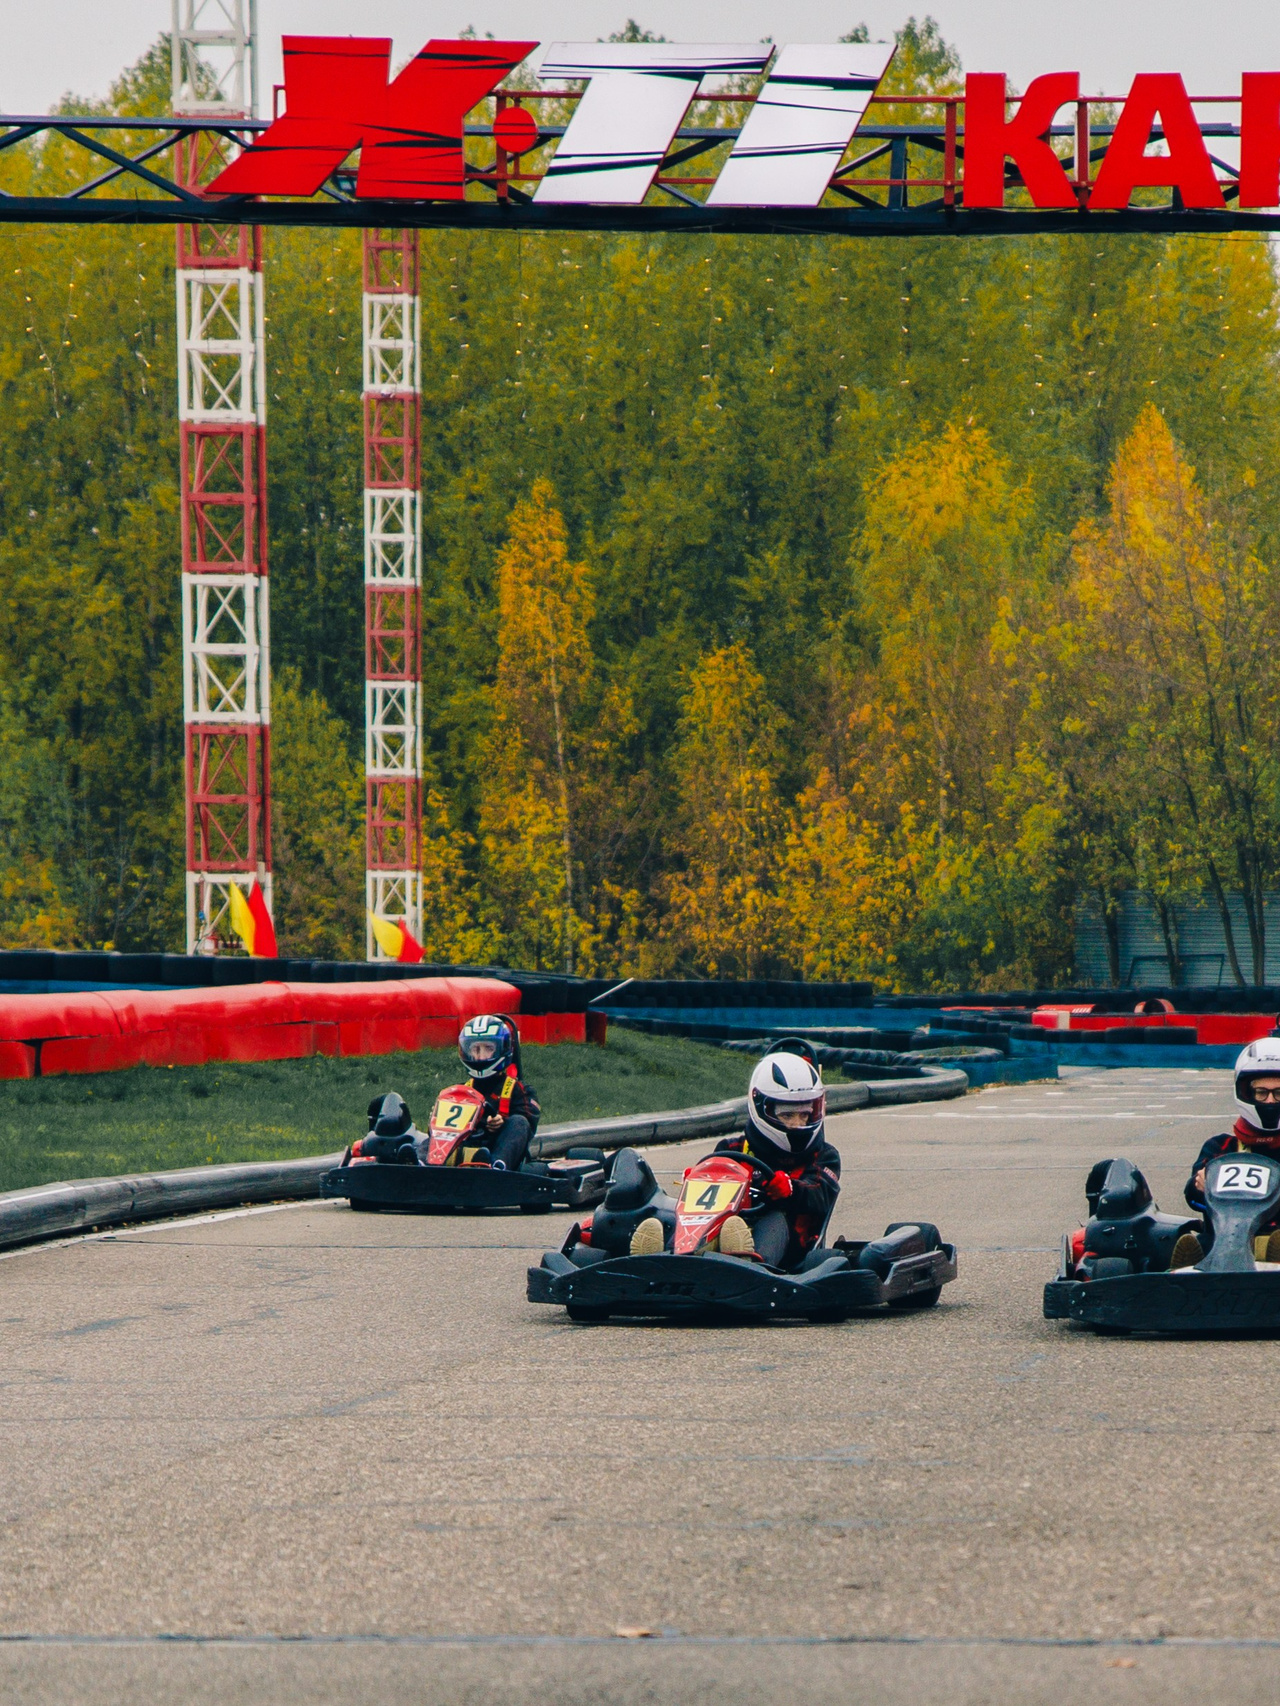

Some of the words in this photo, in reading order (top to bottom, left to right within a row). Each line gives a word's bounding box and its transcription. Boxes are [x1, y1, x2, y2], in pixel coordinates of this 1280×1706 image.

[445, 1105, 463, 1128] 2
[1222, 1167, 1263, 1188] 25
[695, 1184, 721, 1210] 4
